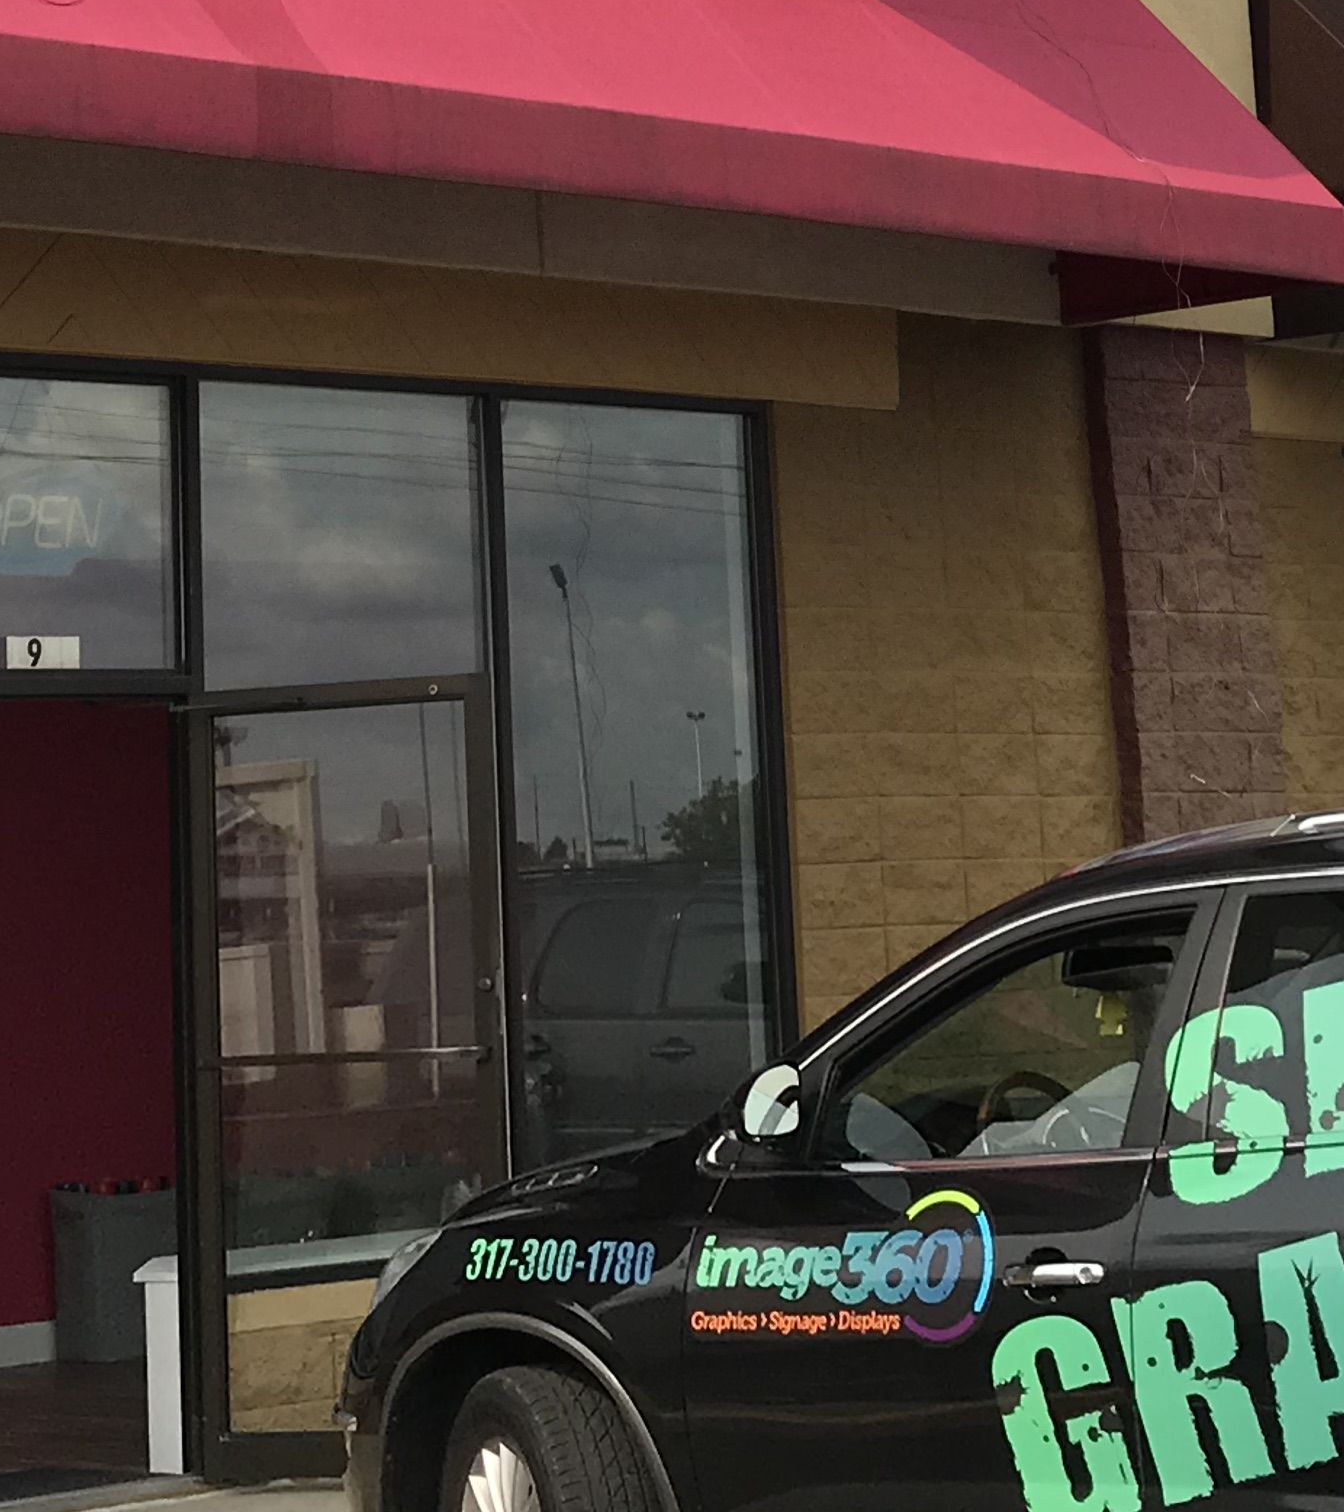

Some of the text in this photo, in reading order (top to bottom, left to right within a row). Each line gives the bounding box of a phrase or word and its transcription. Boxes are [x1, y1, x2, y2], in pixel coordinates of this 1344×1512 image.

[27, 638, 42, 667] 9
[466, 1238, 655, 1286] 317-300-1780
[696, 1229, 964, 1305] image360
[691, 1311, 901, 1335] Graphics Signage Displays
